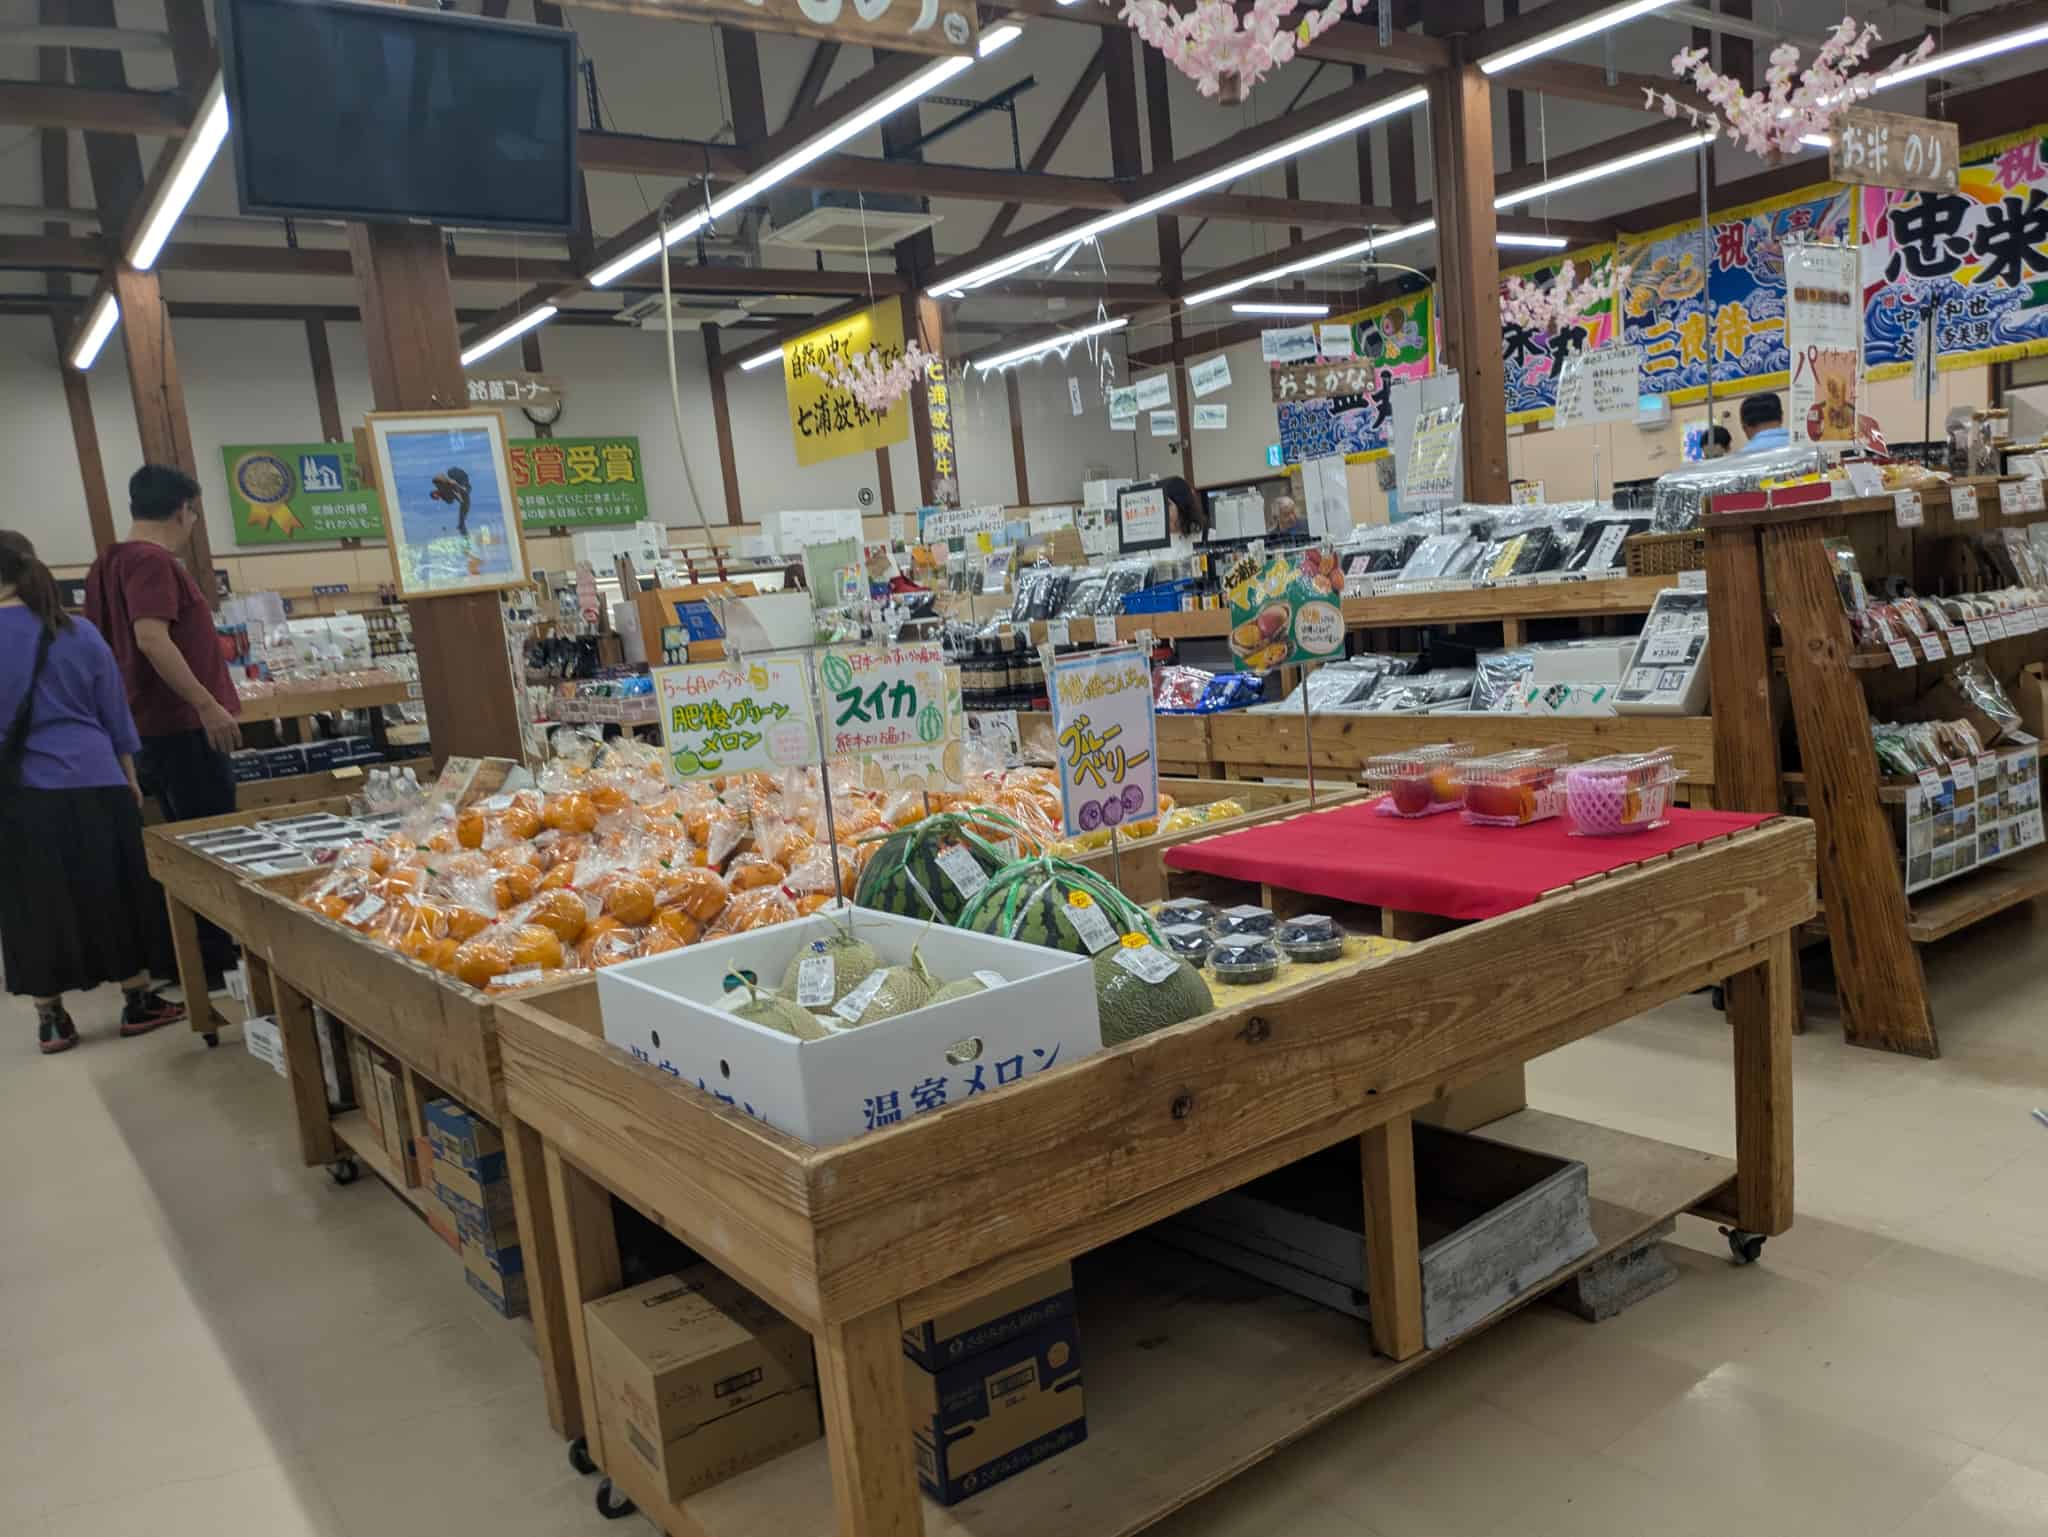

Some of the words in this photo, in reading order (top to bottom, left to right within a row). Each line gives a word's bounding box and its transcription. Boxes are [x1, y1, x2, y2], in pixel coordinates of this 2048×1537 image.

[1842, 122, 1889, 175] お米
[1716, 221, 1748, 272] 祝
[1279, 367, 1374, 399] おさかな。
[671, 695, 790, 733] 肥後グリーン
[835, 679, 917, 727] スイカ
[699, 731, 763, 756] メロン
[1059, 714, 1122, 767] ブルー
[1073, 745, 1150, 789] ベリー
[863, 1040, 1062, 1118] 温室メロン
